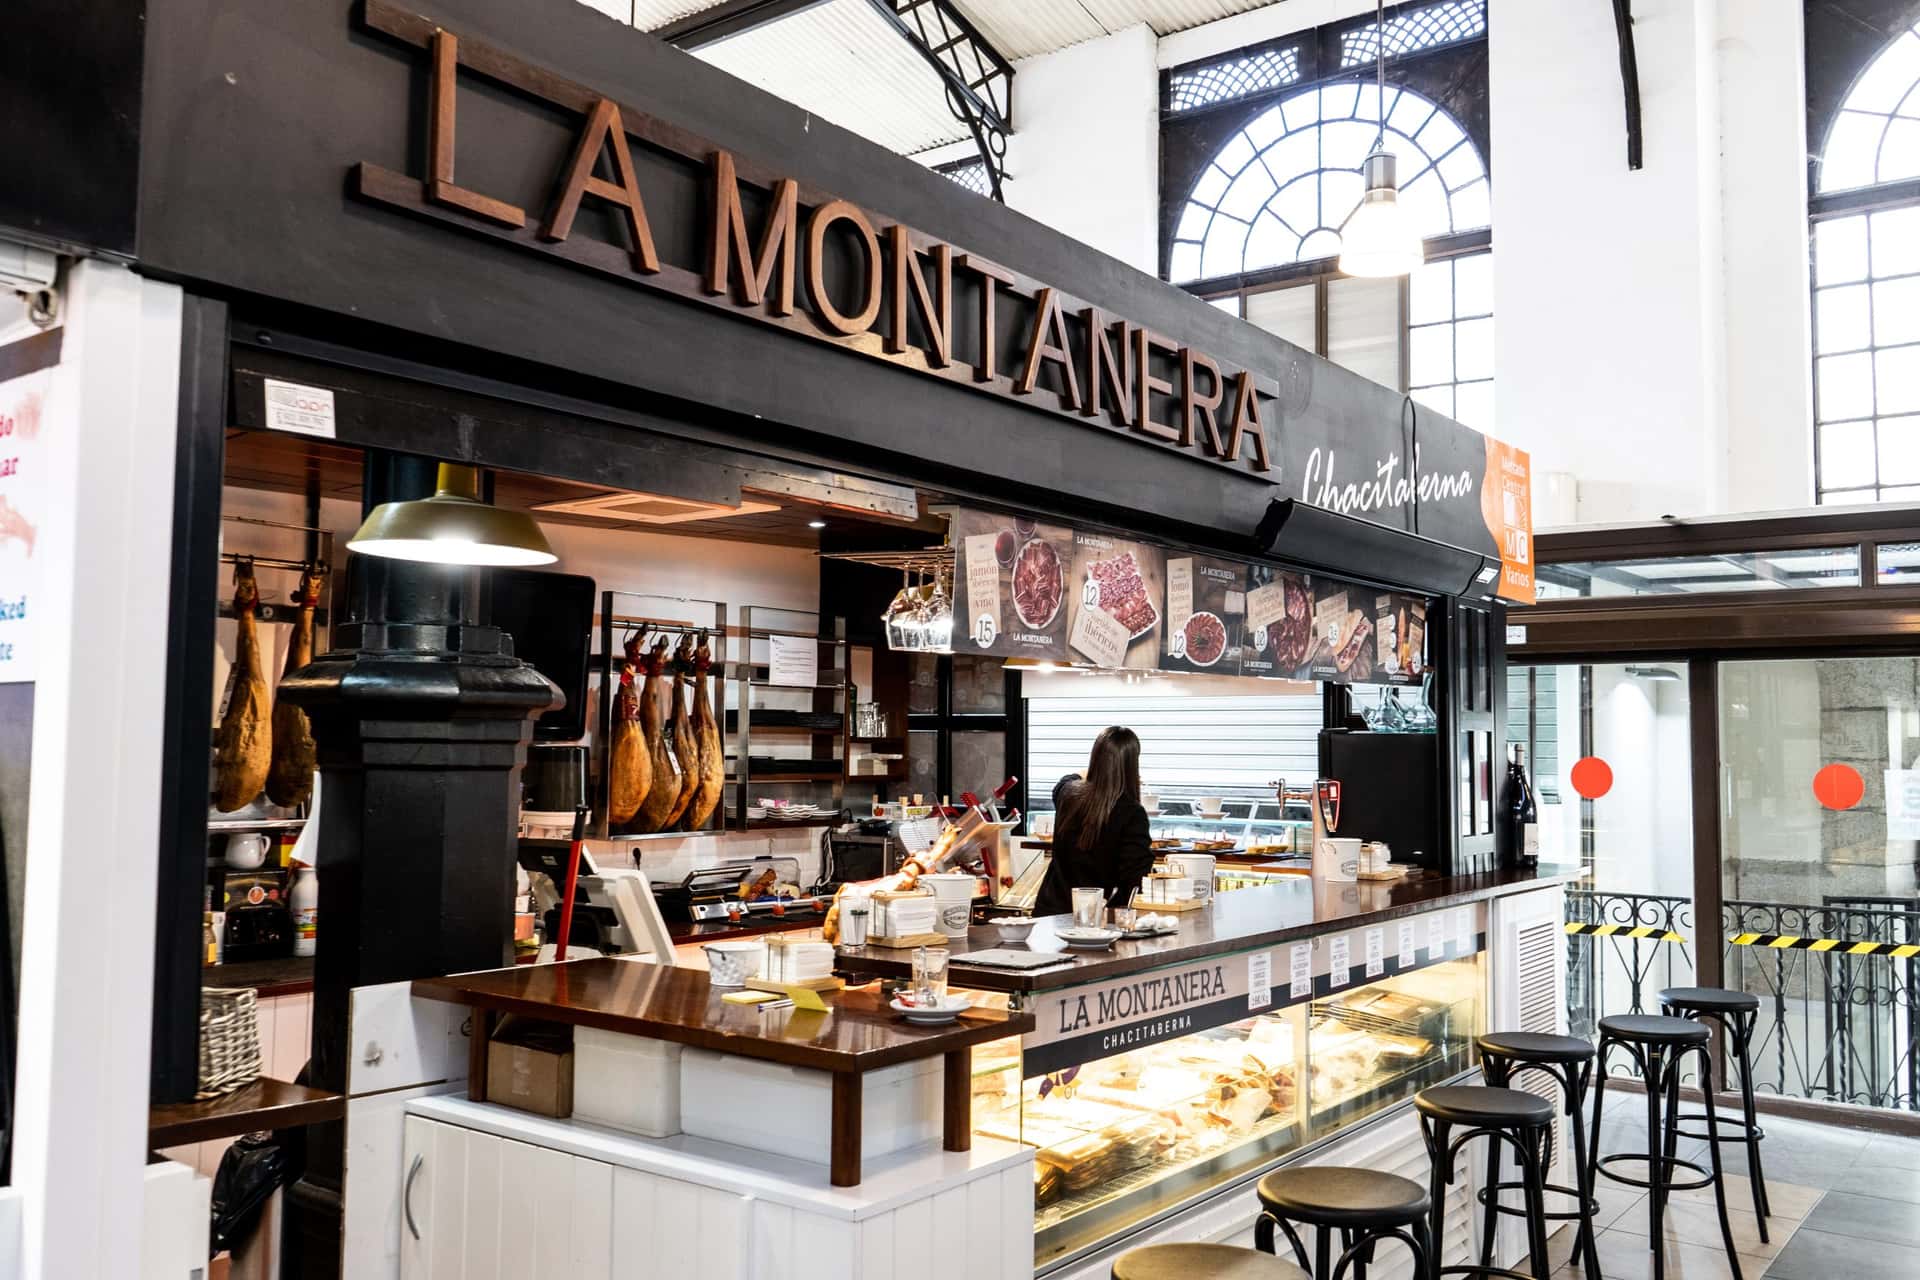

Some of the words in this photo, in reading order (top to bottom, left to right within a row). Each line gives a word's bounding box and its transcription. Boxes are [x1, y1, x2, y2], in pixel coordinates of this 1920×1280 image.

[430, 27, 660, 275] LA
[708, 150, 1271, 471] MONTANERA
[1085, 585, 1097, 606] 12
[979, 620, 993, 642] 15
[1059, 995, 1091, 1034] LA
[1098, 966, 1226, 1025] MONTANERA
[1103, 1015, 1192, 1050] CHACITABERNA
